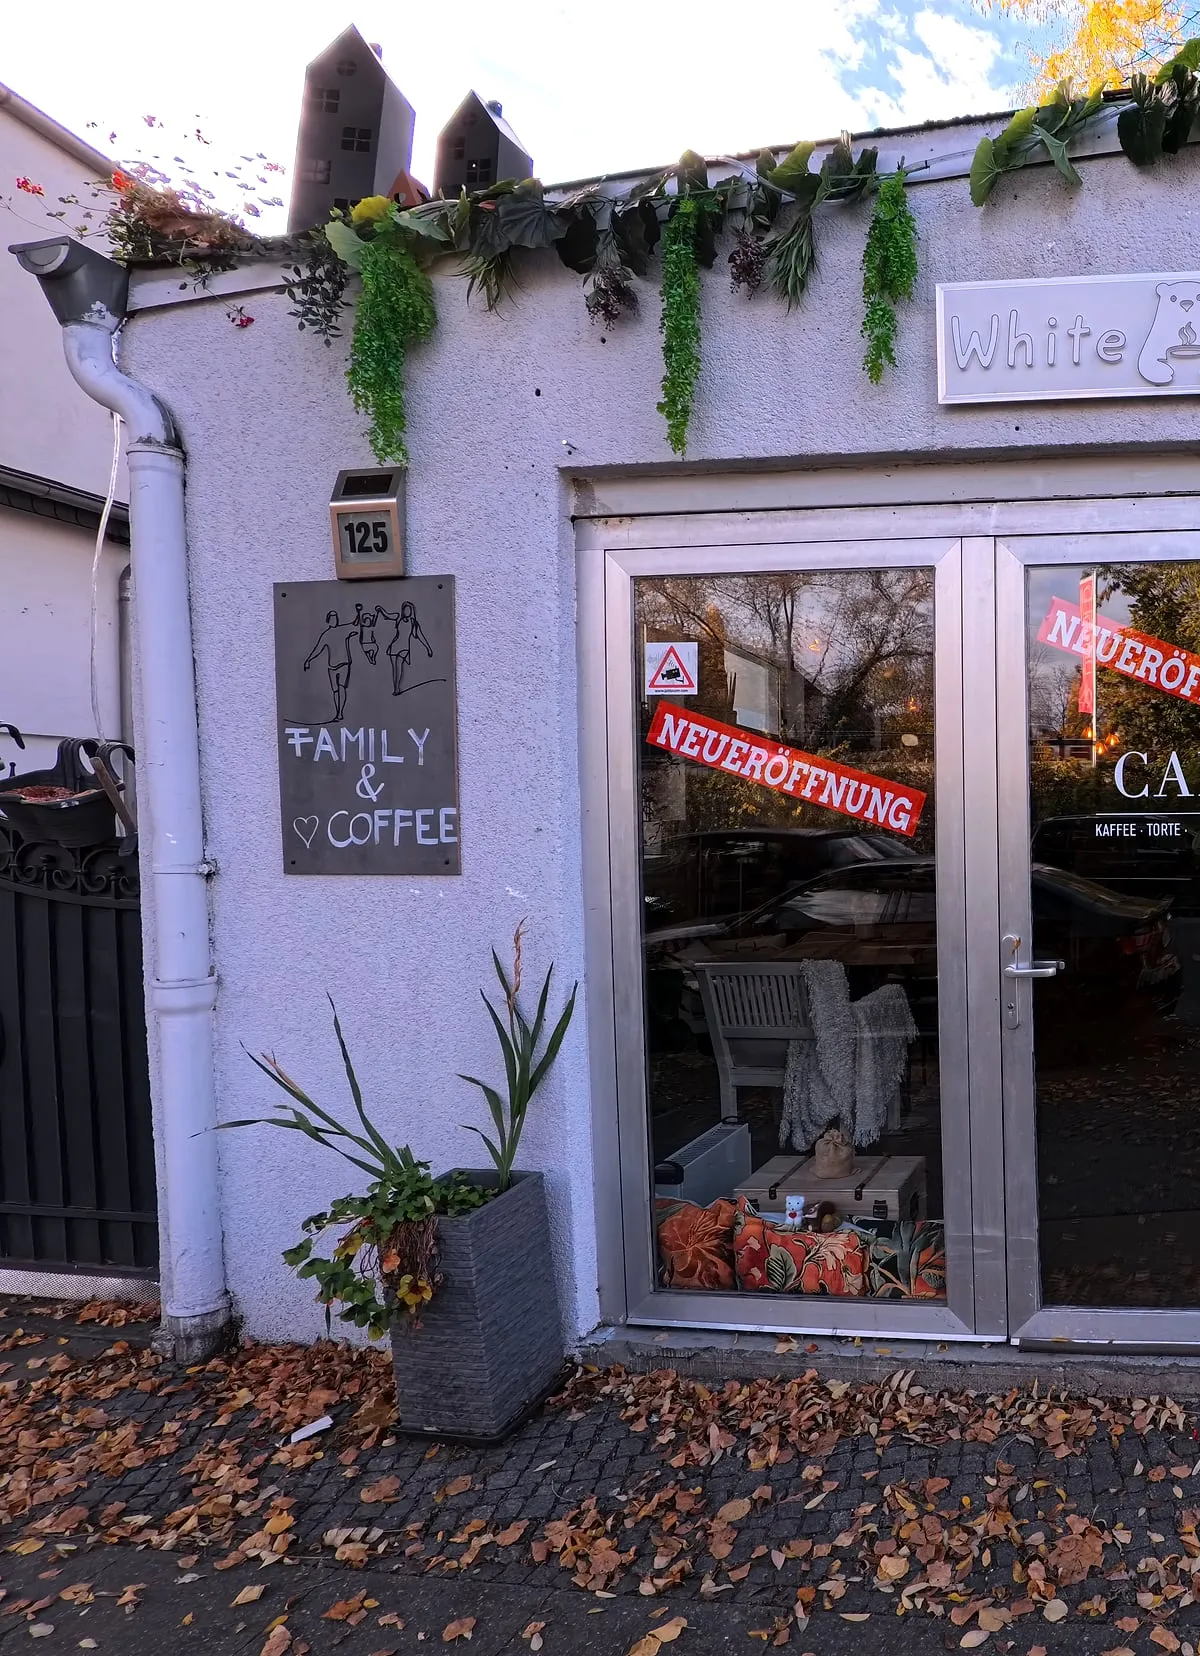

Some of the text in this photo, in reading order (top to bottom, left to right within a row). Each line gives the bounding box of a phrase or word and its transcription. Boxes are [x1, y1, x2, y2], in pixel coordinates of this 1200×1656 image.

[951, 308, 1127, 371] White
[344, 521, 388, 553] 125
[284, 726, 431, 766] FAMILY
[355, 763, 385, 802] &
[656, 713, 913, 832] NEUERÖFFNUNG
[327, 807, 458, 848] COFFEE
[1095, 823, 1181, 837] KAFFEE TORTE
